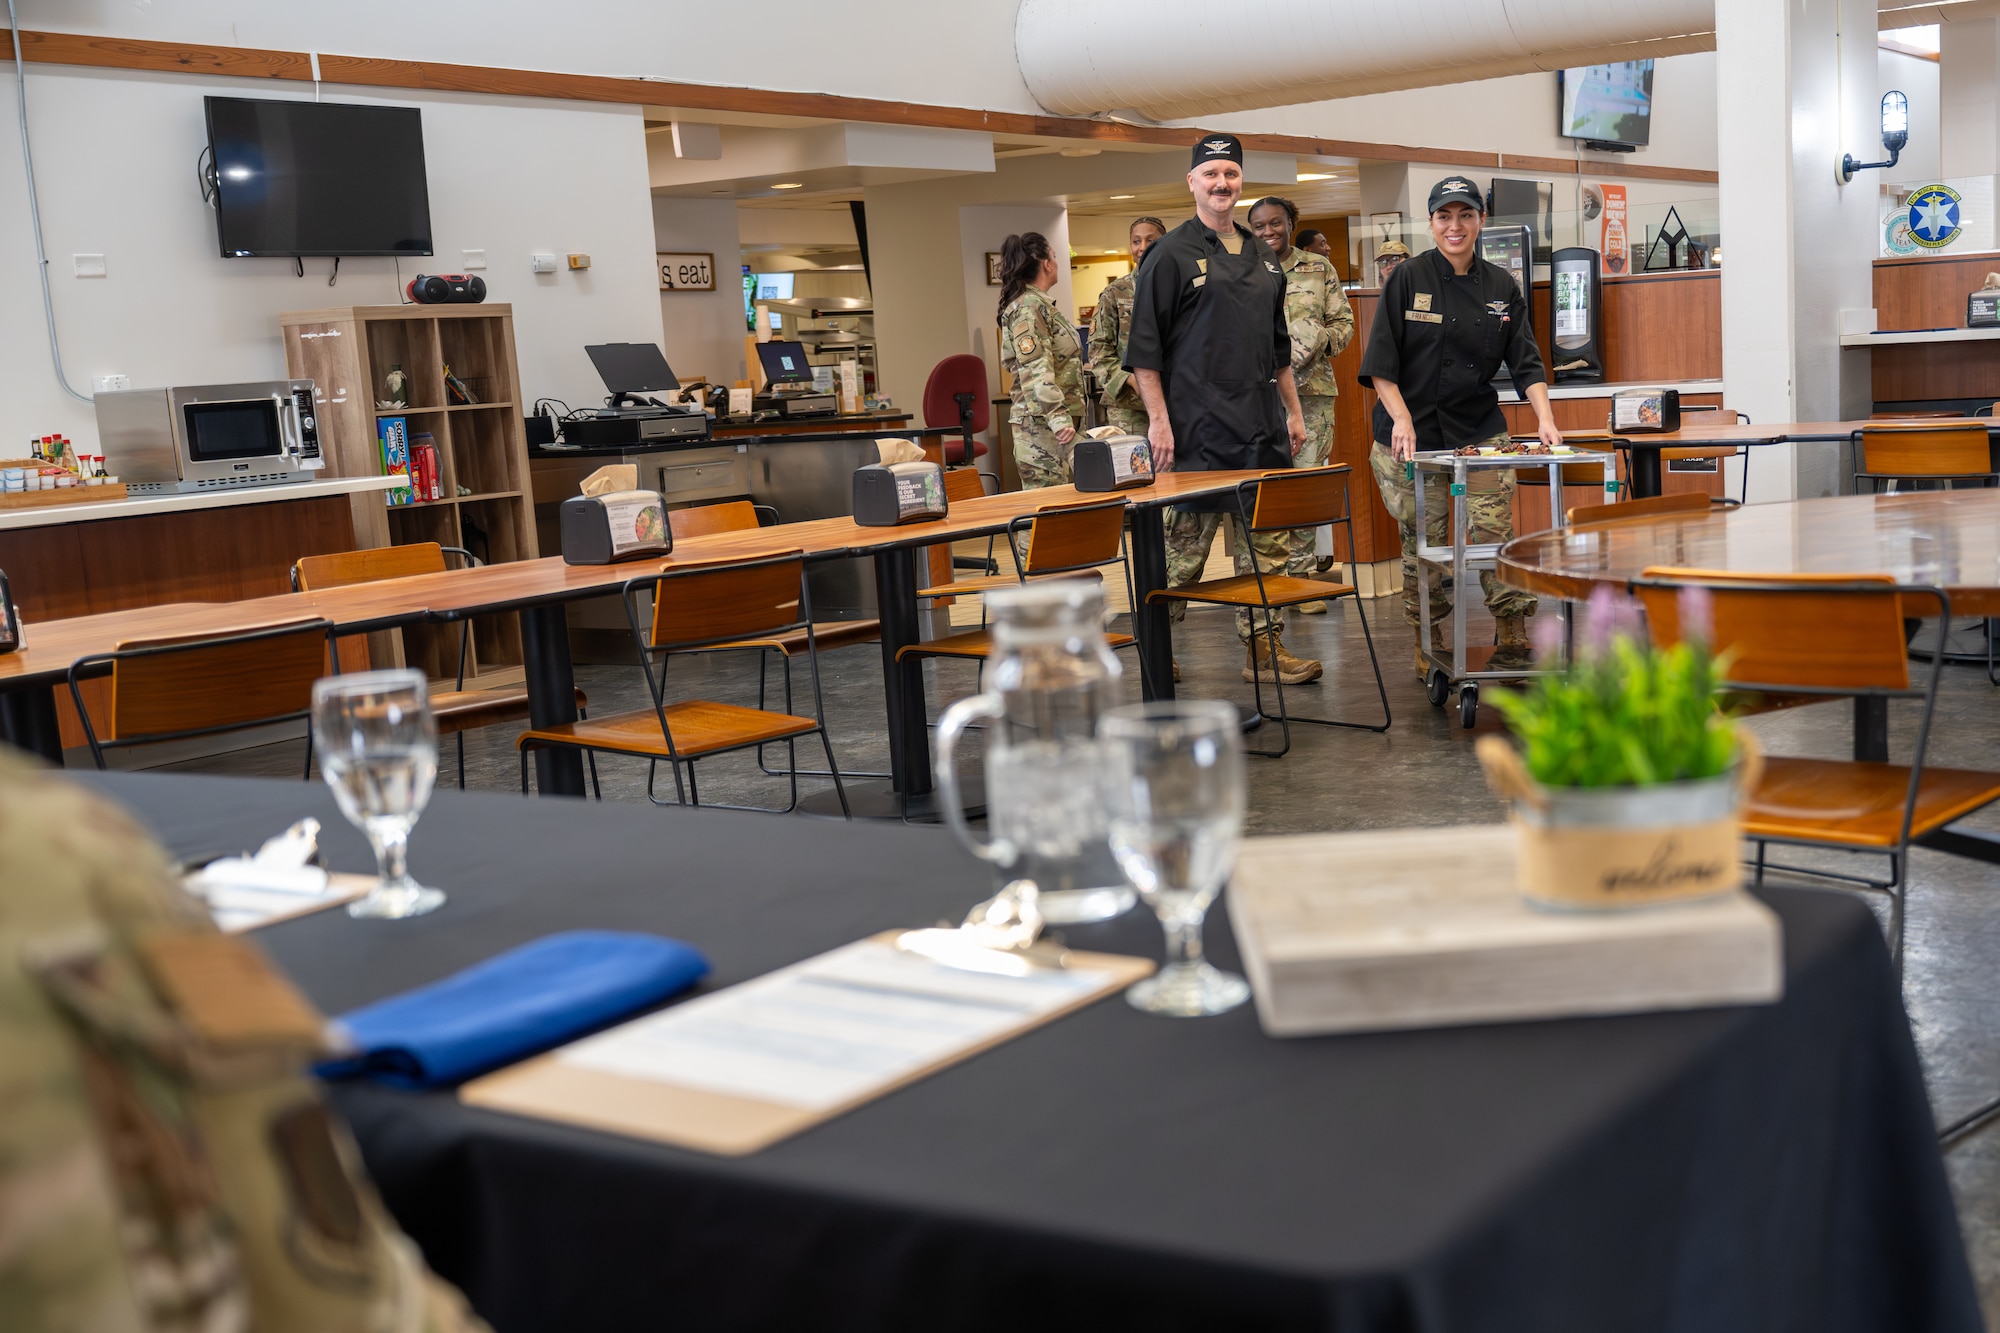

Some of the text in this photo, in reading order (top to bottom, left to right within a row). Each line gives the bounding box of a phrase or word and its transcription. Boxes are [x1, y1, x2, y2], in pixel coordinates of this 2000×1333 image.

[1917, 186, 1934, 196] MEDICAL
[1937, 186, 1953, 196] SUPPORT
[678, 260, 709, 284] eat
[1411, 312, 1433, 320] FRANCO
[395, 422, 406, 457] SORRY!
